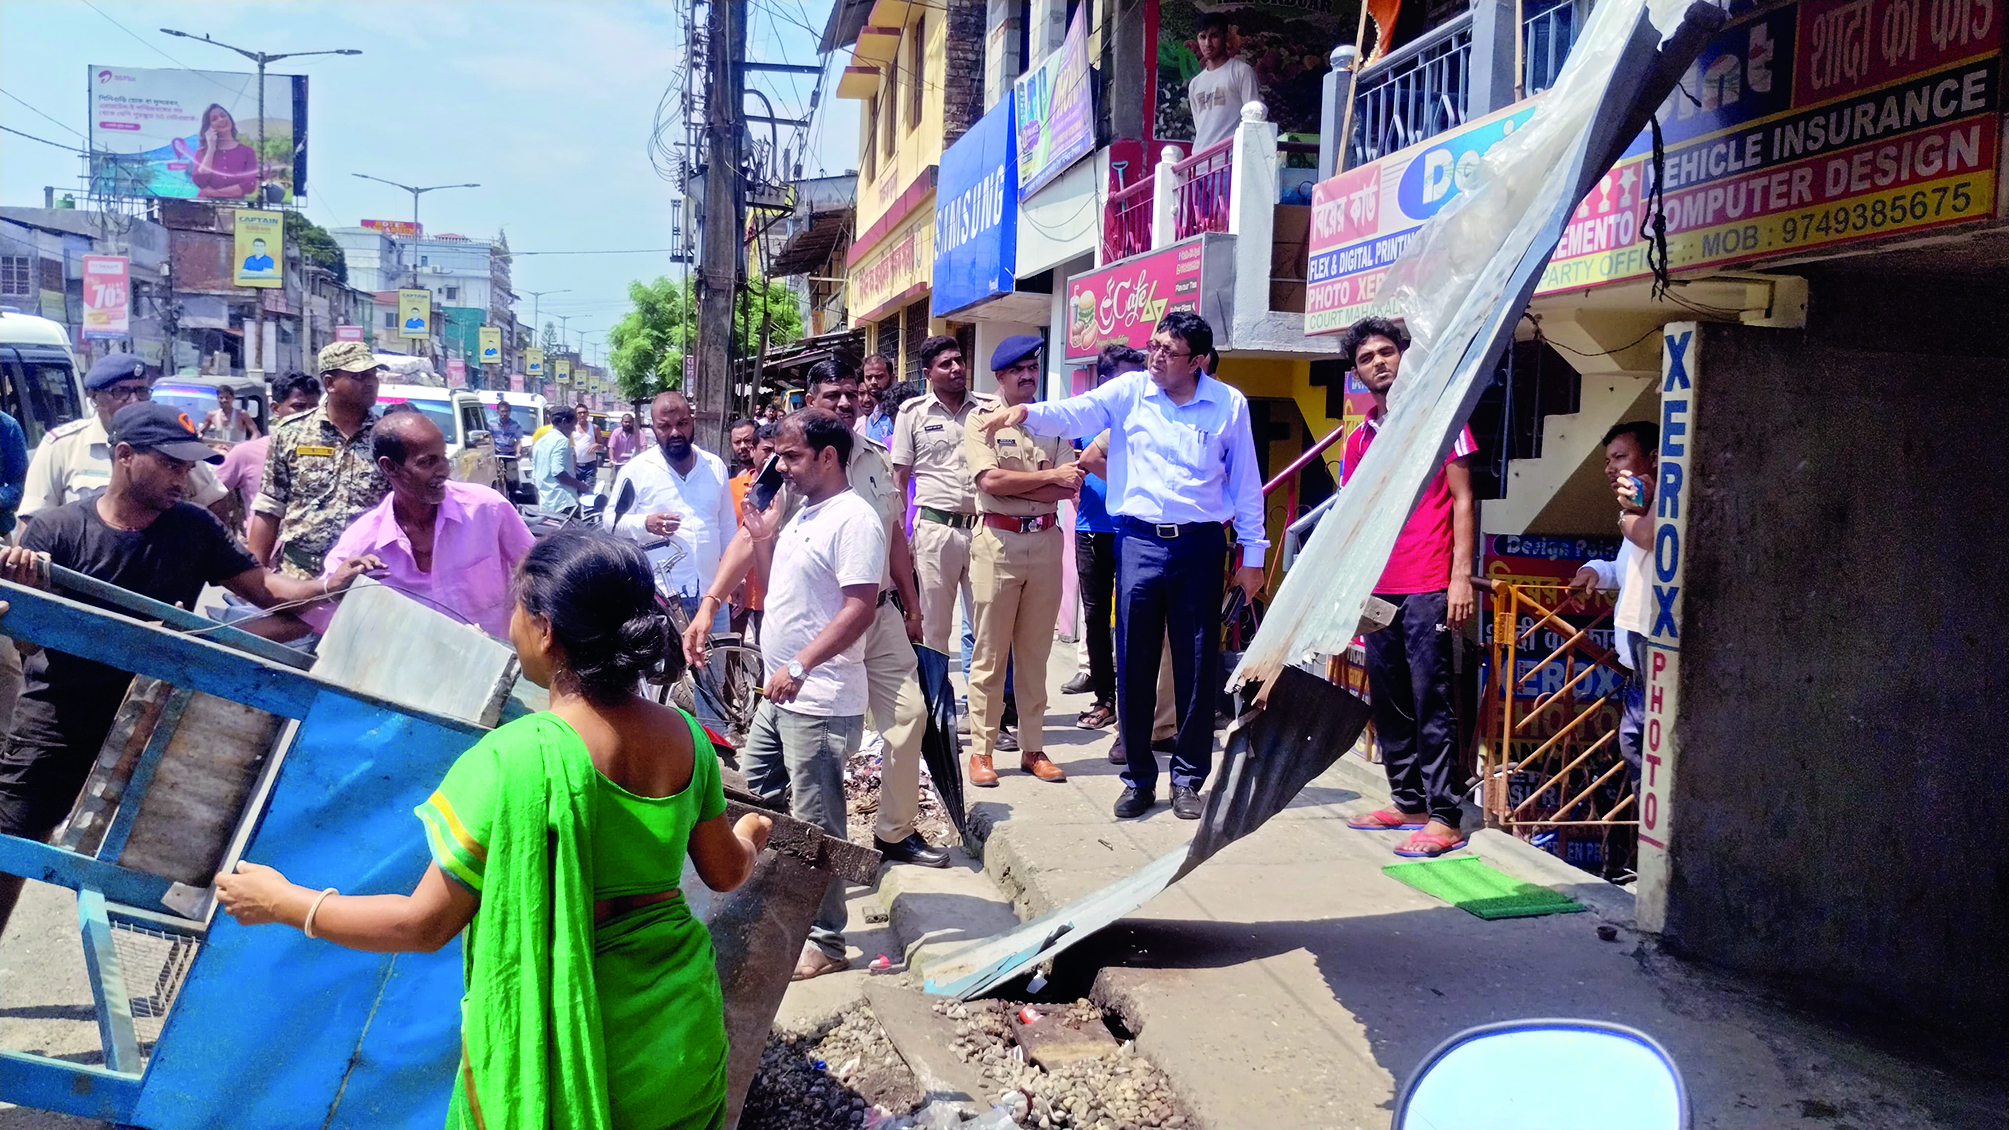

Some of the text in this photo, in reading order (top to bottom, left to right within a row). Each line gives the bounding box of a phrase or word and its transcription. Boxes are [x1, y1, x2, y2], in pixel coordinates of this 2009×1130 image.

[1647, 69, 1988, 190] VEHICLE INSURANCE
[935, 164, 1005, 261] SAMSUNG
[1350, 169, 1379, 229] কার্ড
[1645, 125, 1981, 239] COMPUTER DESIGN
[239, 216, 279, 224] CAPTAIN
[1702, 225, 1759, 258] MOB
[1782, 182, 1972, 244] 9749385675
[1309, 232, 1415, 281] FLEX & DIGITAL PRINTIN
[1307, 280, 1350, 311] PHOTO
[1310, 309, 1344, 331] COURT
[1654, 331, 1693, 639] XEROX
[1506, 535, 1622, 560] Design Poin
[1644, 652, 1667, 832] PHOTO
